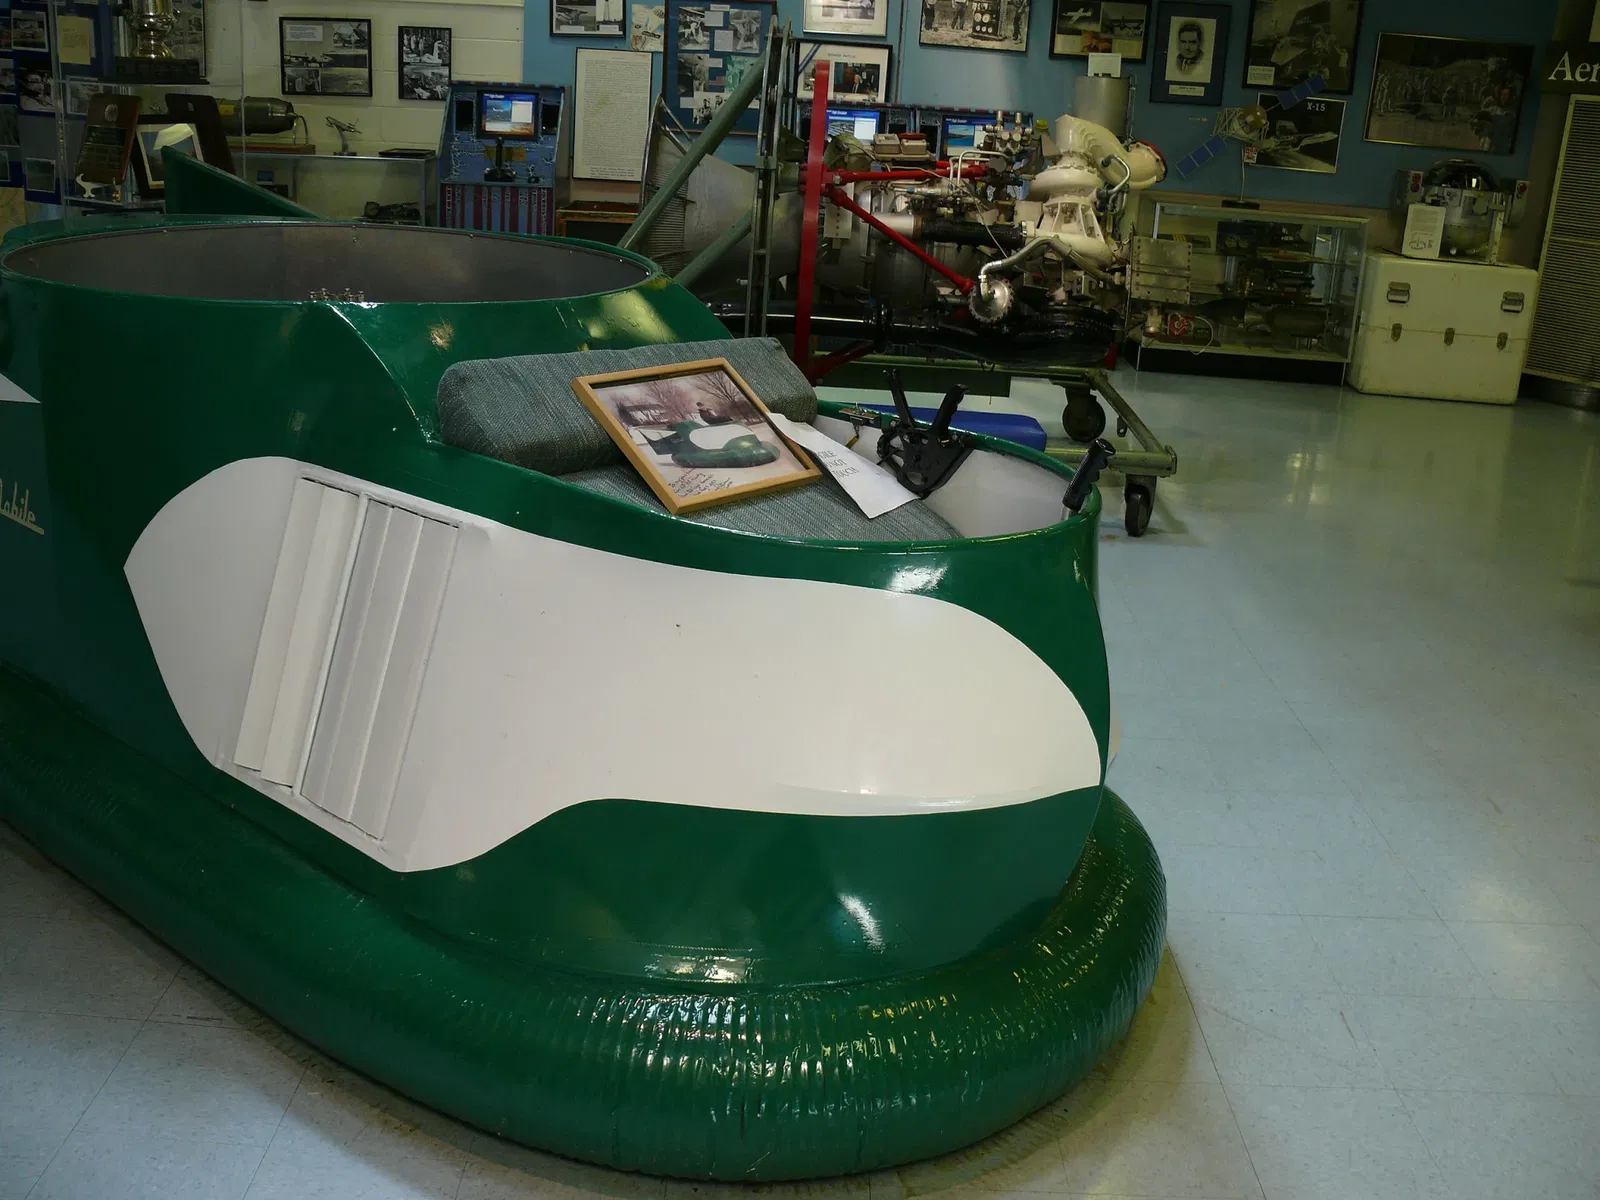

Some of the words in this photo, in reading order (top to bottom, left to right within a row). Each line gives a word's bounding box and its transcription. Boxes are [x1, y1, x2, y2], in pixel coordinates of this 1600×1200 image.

[1547, 50, 1600, 82] Aer
[1306, 101, 1326, 112] X-15
[832, 466, 860, 477] TOUCH
